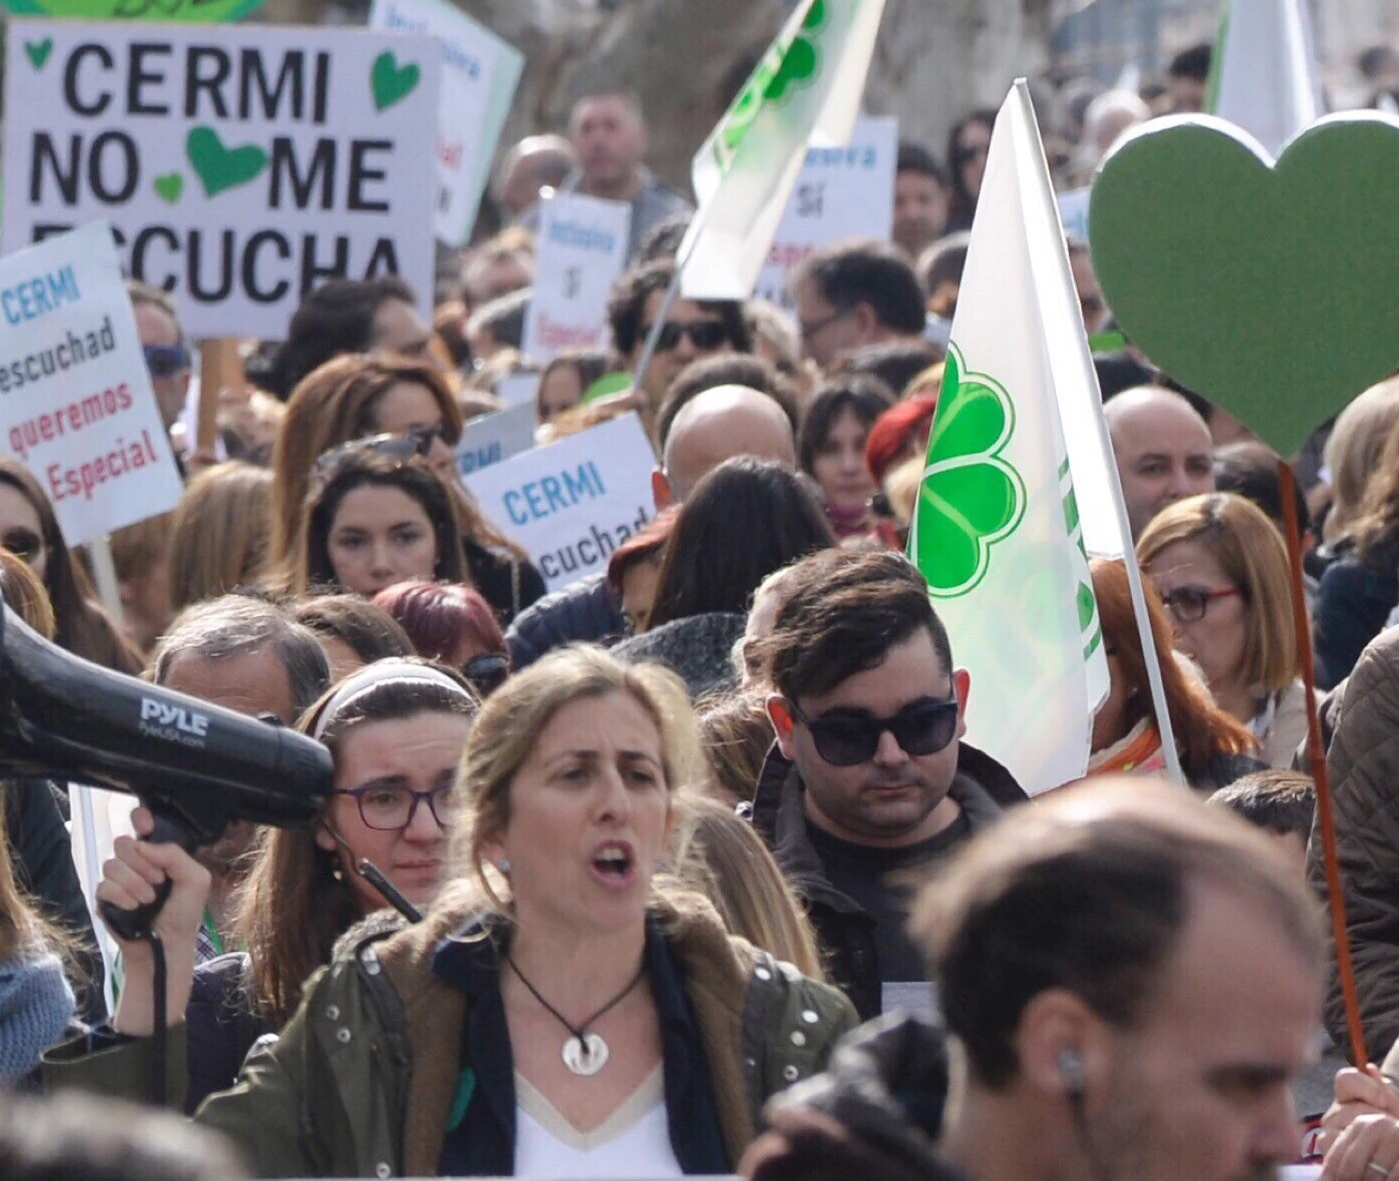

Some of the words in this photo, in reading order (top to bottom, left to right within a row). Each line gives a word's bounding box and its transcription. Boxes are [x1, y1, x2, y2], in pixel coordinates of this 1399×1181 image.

[63, 43, 331, 125] CERMI
[27, 130, 141, 206] NO
[267, 136, 394, 214] ME
[1, 266, 80, 325] CERMI
[8, 382, 133, 459] queremos
[46, 429, 158, 501] Especial
[502, 460, 605, 526] CERMI
